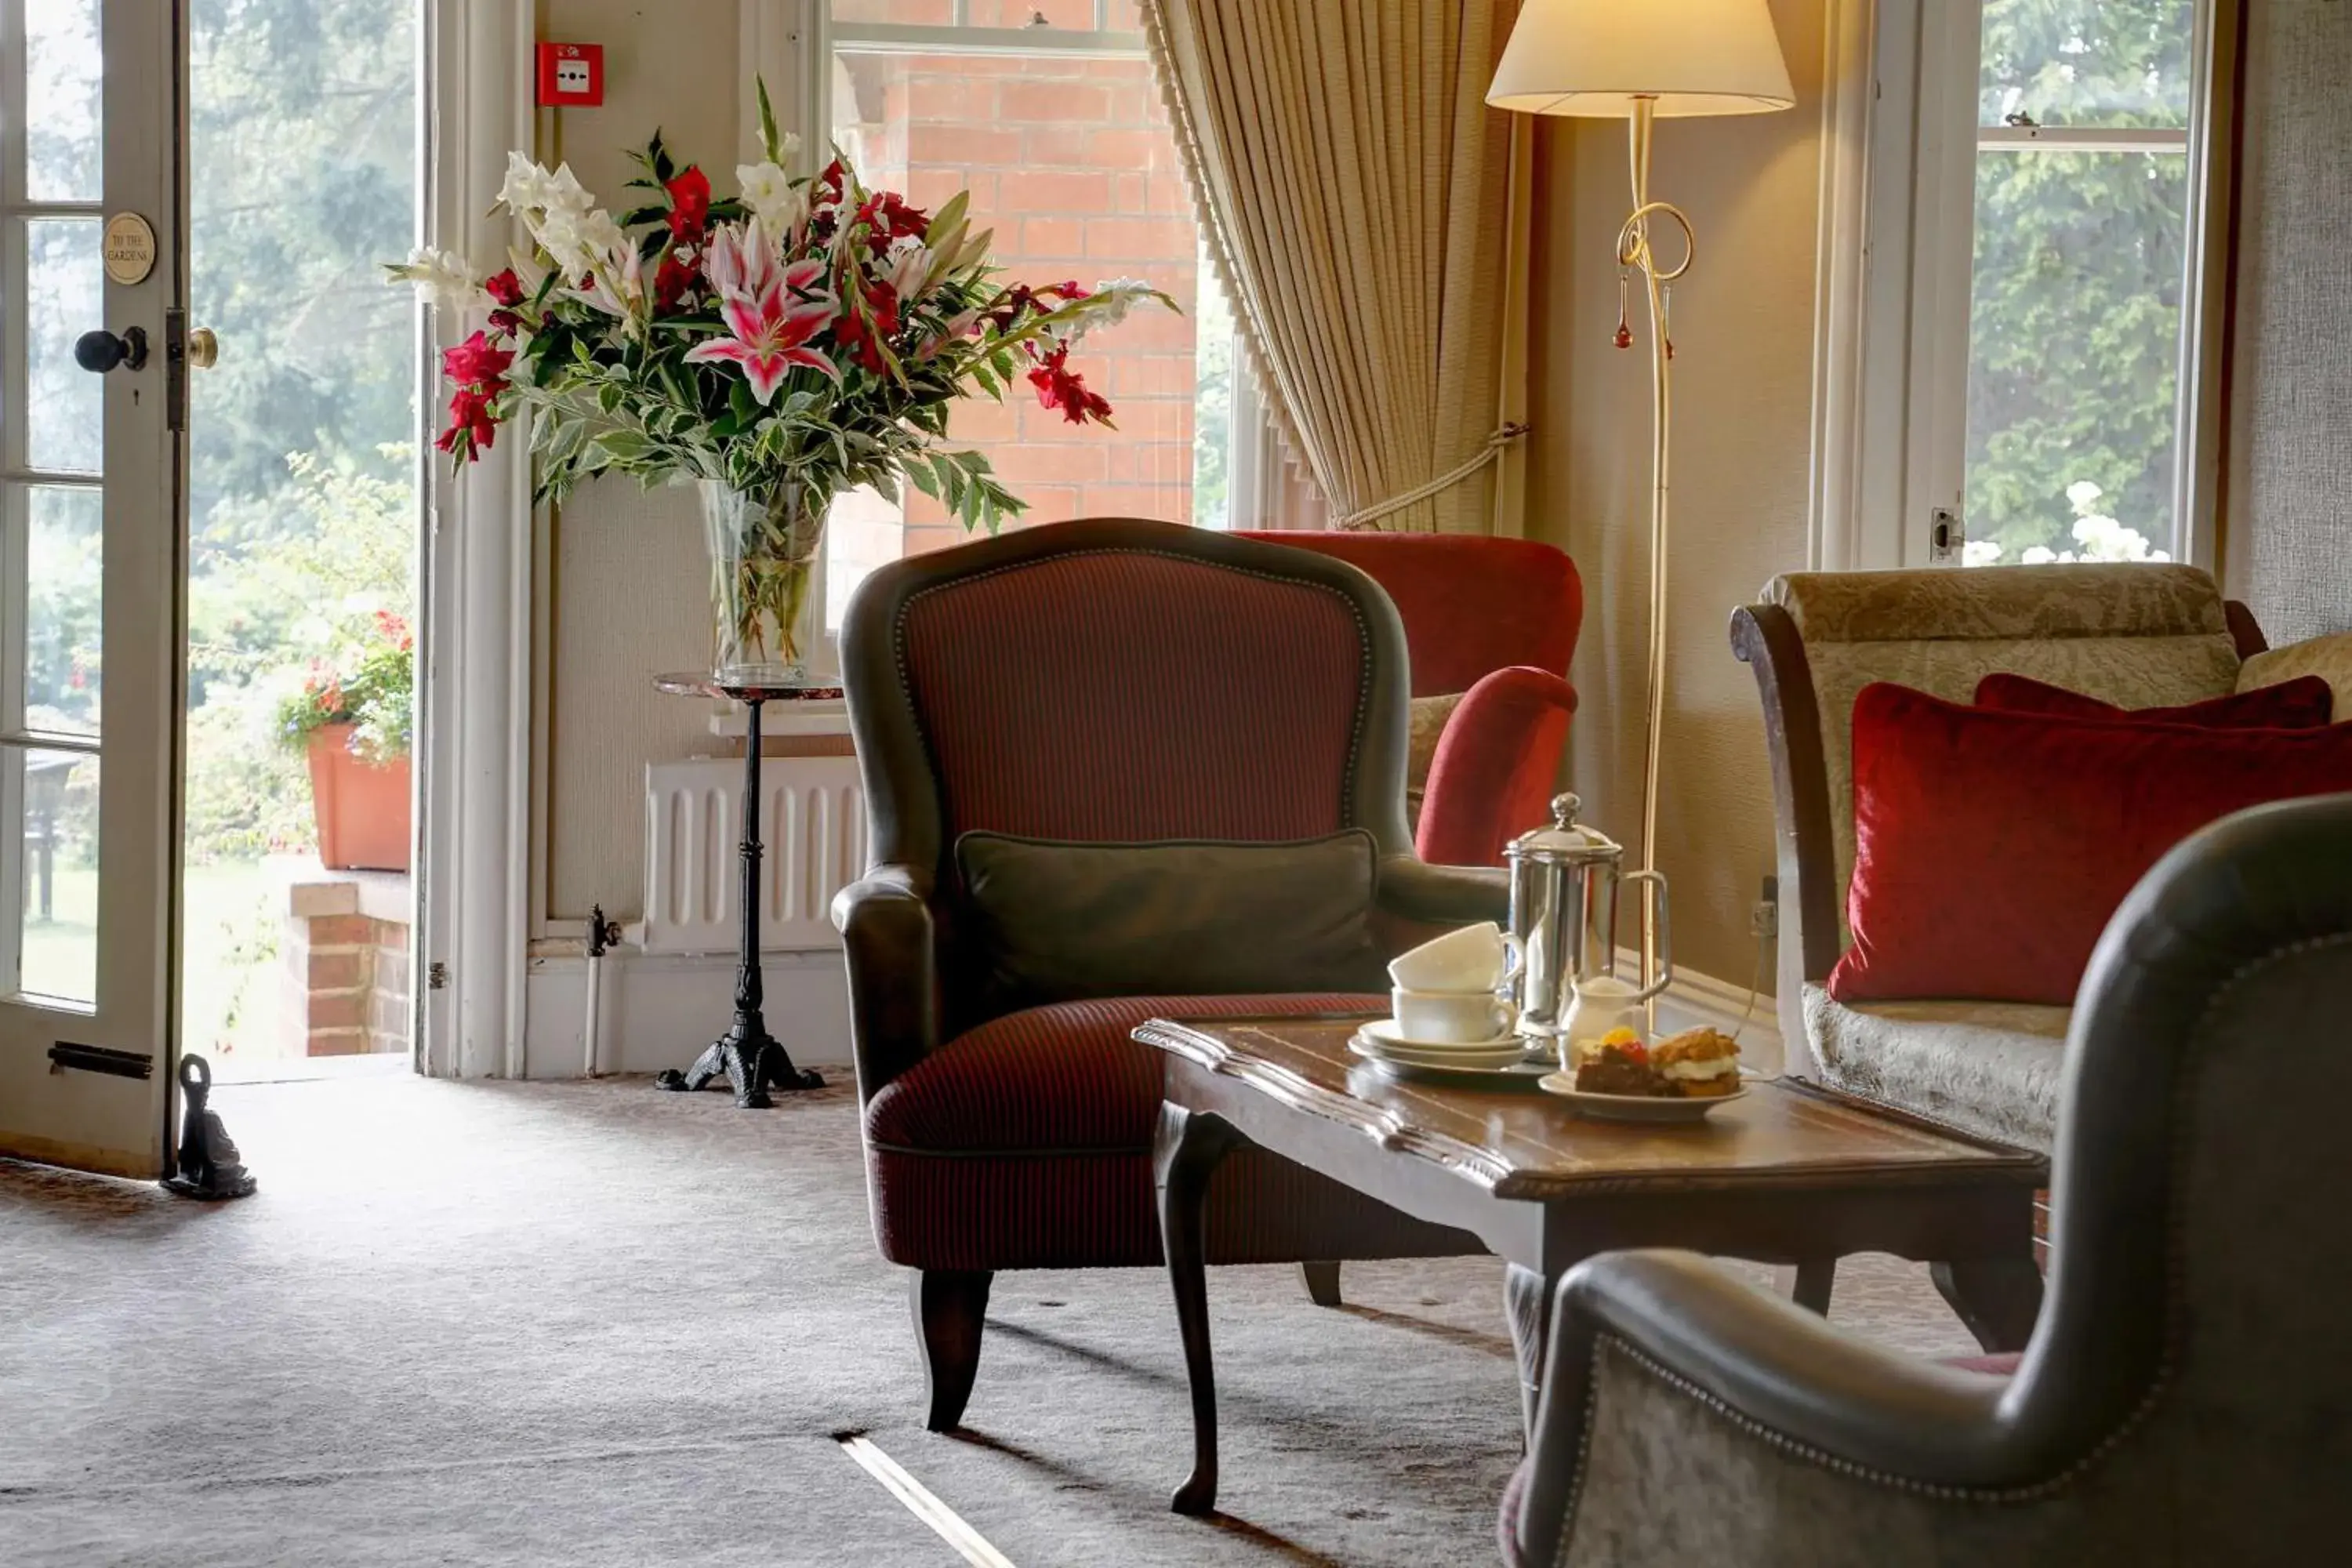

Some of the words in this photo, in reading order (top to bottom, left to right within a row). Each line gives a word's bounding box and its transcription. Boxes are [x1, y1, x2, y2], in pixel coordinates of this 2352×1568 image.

[113, 234, 123, 245] TO
[126, 234, 144, 245] THE
[107, 250, 147, 261] GARDENS
